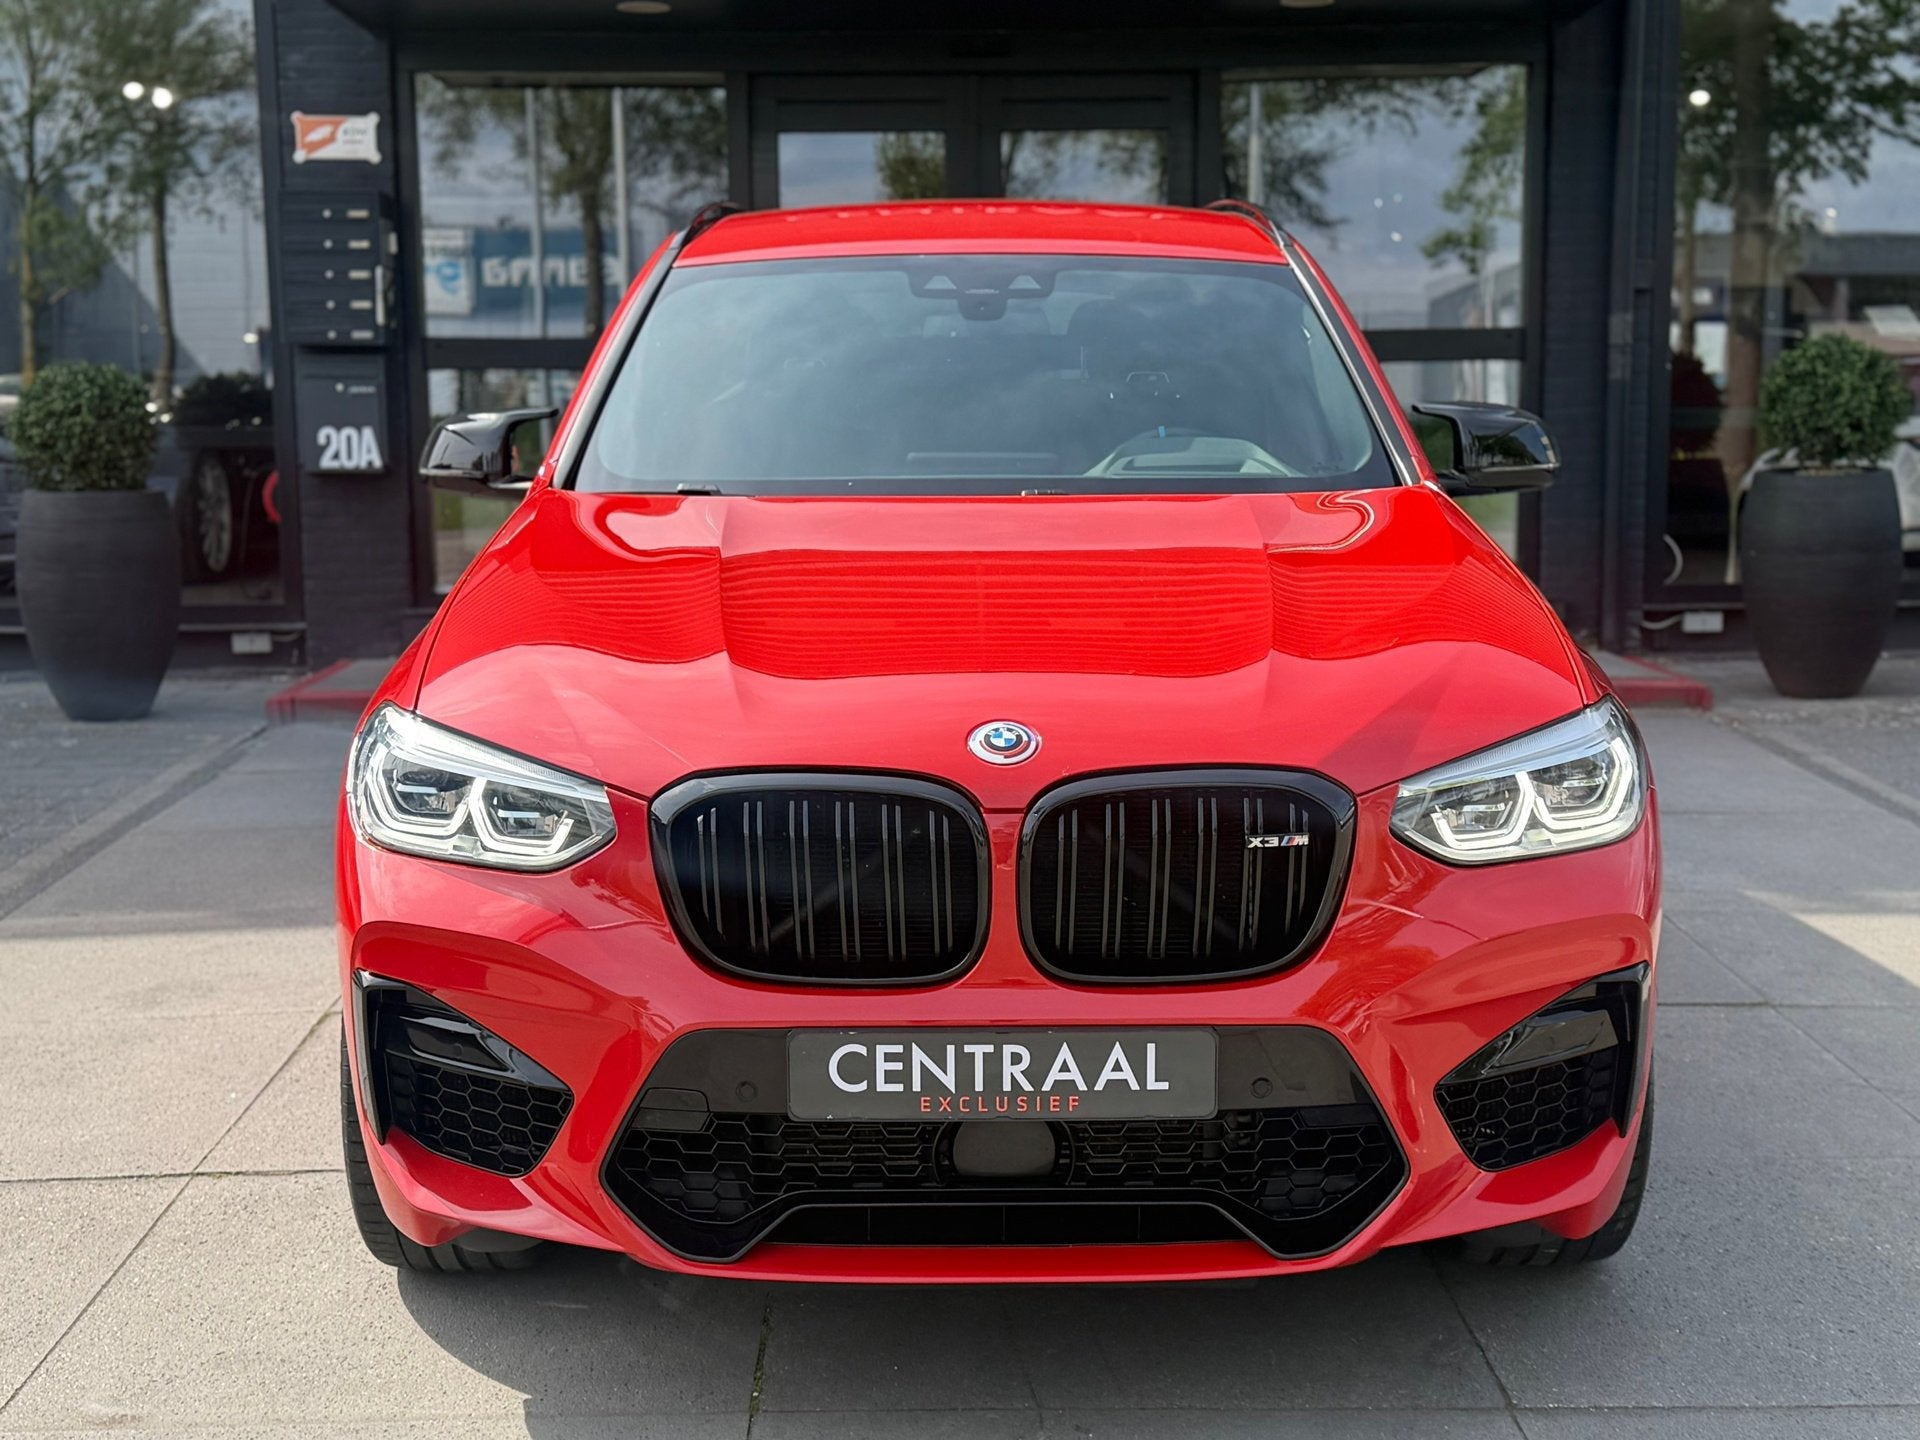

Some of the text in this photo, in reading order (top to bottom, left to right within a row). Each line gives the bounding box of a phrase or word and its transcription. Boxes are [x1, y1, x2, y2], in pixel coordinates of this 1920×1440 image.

[317, 425, 382, 469] 20A
[828, 1041, 1169, 1093] CENTRAAL
[920, 1096, 1080, 1112] EXCLUSIEF
